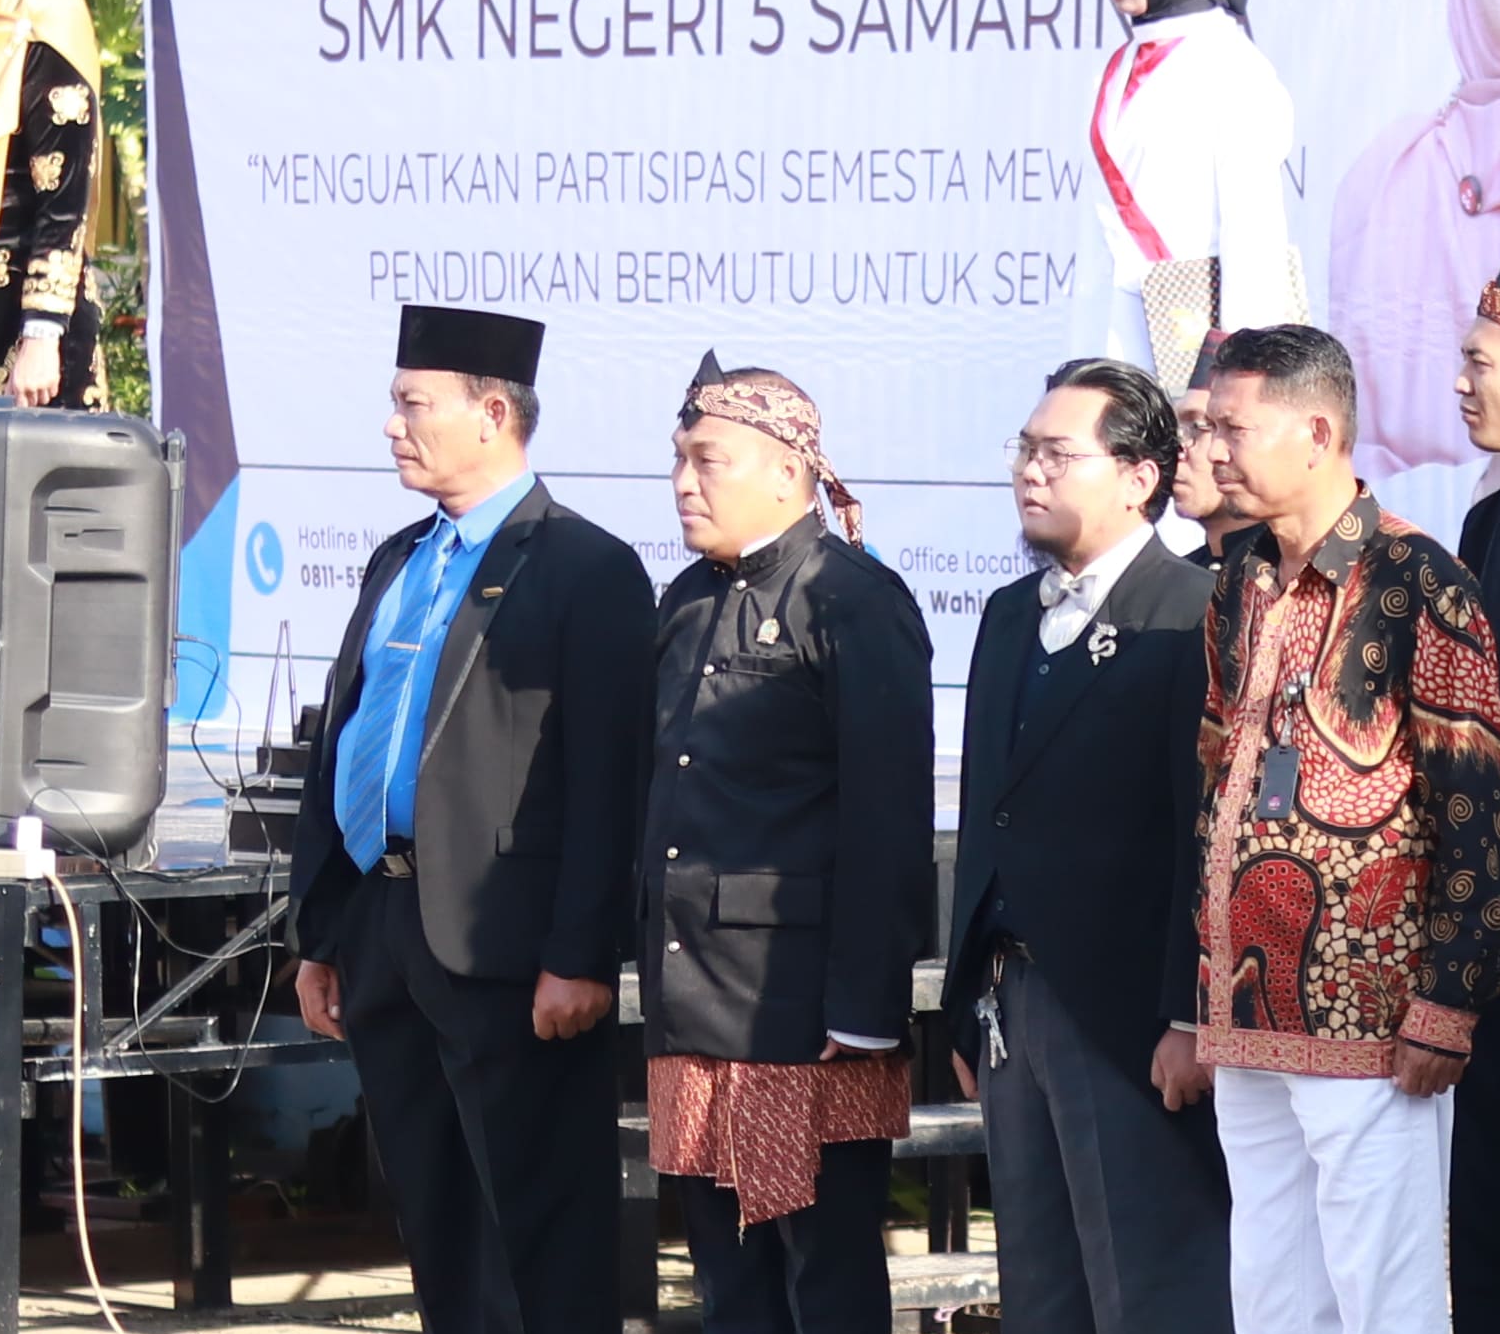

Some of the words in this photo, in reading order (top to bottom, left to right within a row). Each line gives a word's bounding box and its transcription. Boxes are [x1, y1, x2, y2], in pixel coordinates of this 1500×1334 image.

[536, 149, 765, 204] PARTISIPASI
[780, 148, 969, 204] SEMESTA
[369, 250, 600, 303] PENDIDIKAN
[616, 250, 814, 305] BERMUTU
[832, 251, 979, 306] UNTUK
[992, 250, 1077, 306] SEM
[299, 526, 357, 551] Hotline
[899, 546, 959, 574] Office
[966, 550, 1035, 575] Locati
[929, 588, 988, 616] Wahi
